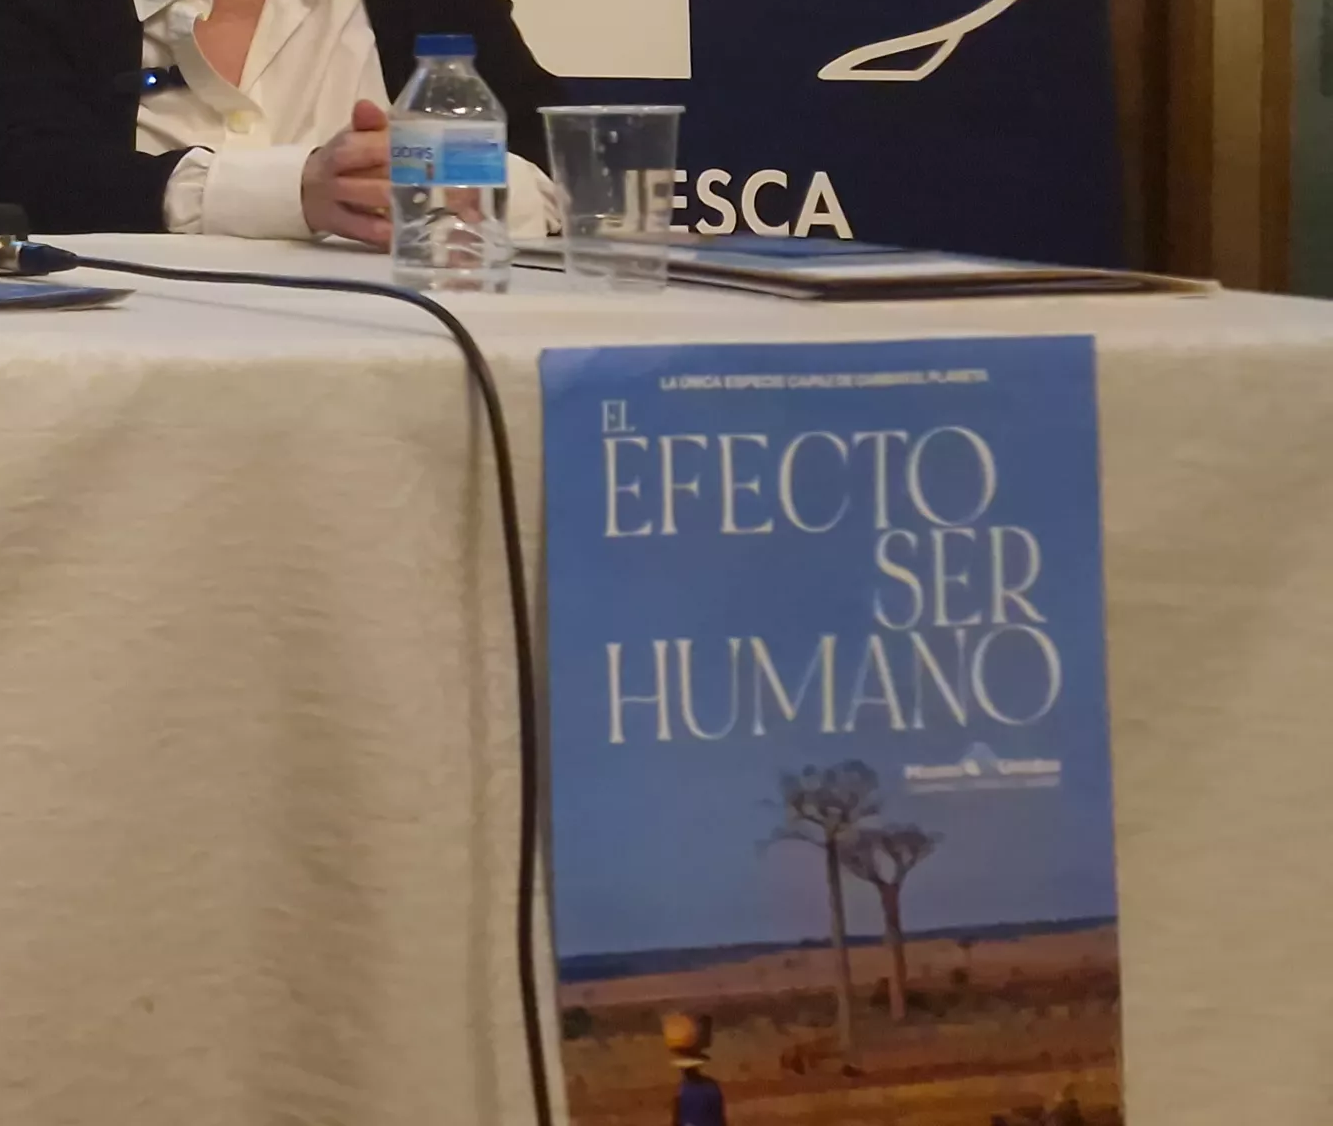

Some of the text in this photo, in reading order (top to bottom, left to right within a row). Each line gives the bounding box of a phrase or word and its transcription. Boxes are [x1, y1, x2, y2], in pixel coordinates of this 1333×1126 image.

[601, 399, 635, 432] EL
[602, 425, 998, 538] EFECTO
[873, 525, 1048, 631] SER
[606, 622, 1063, 744] HUMANO
